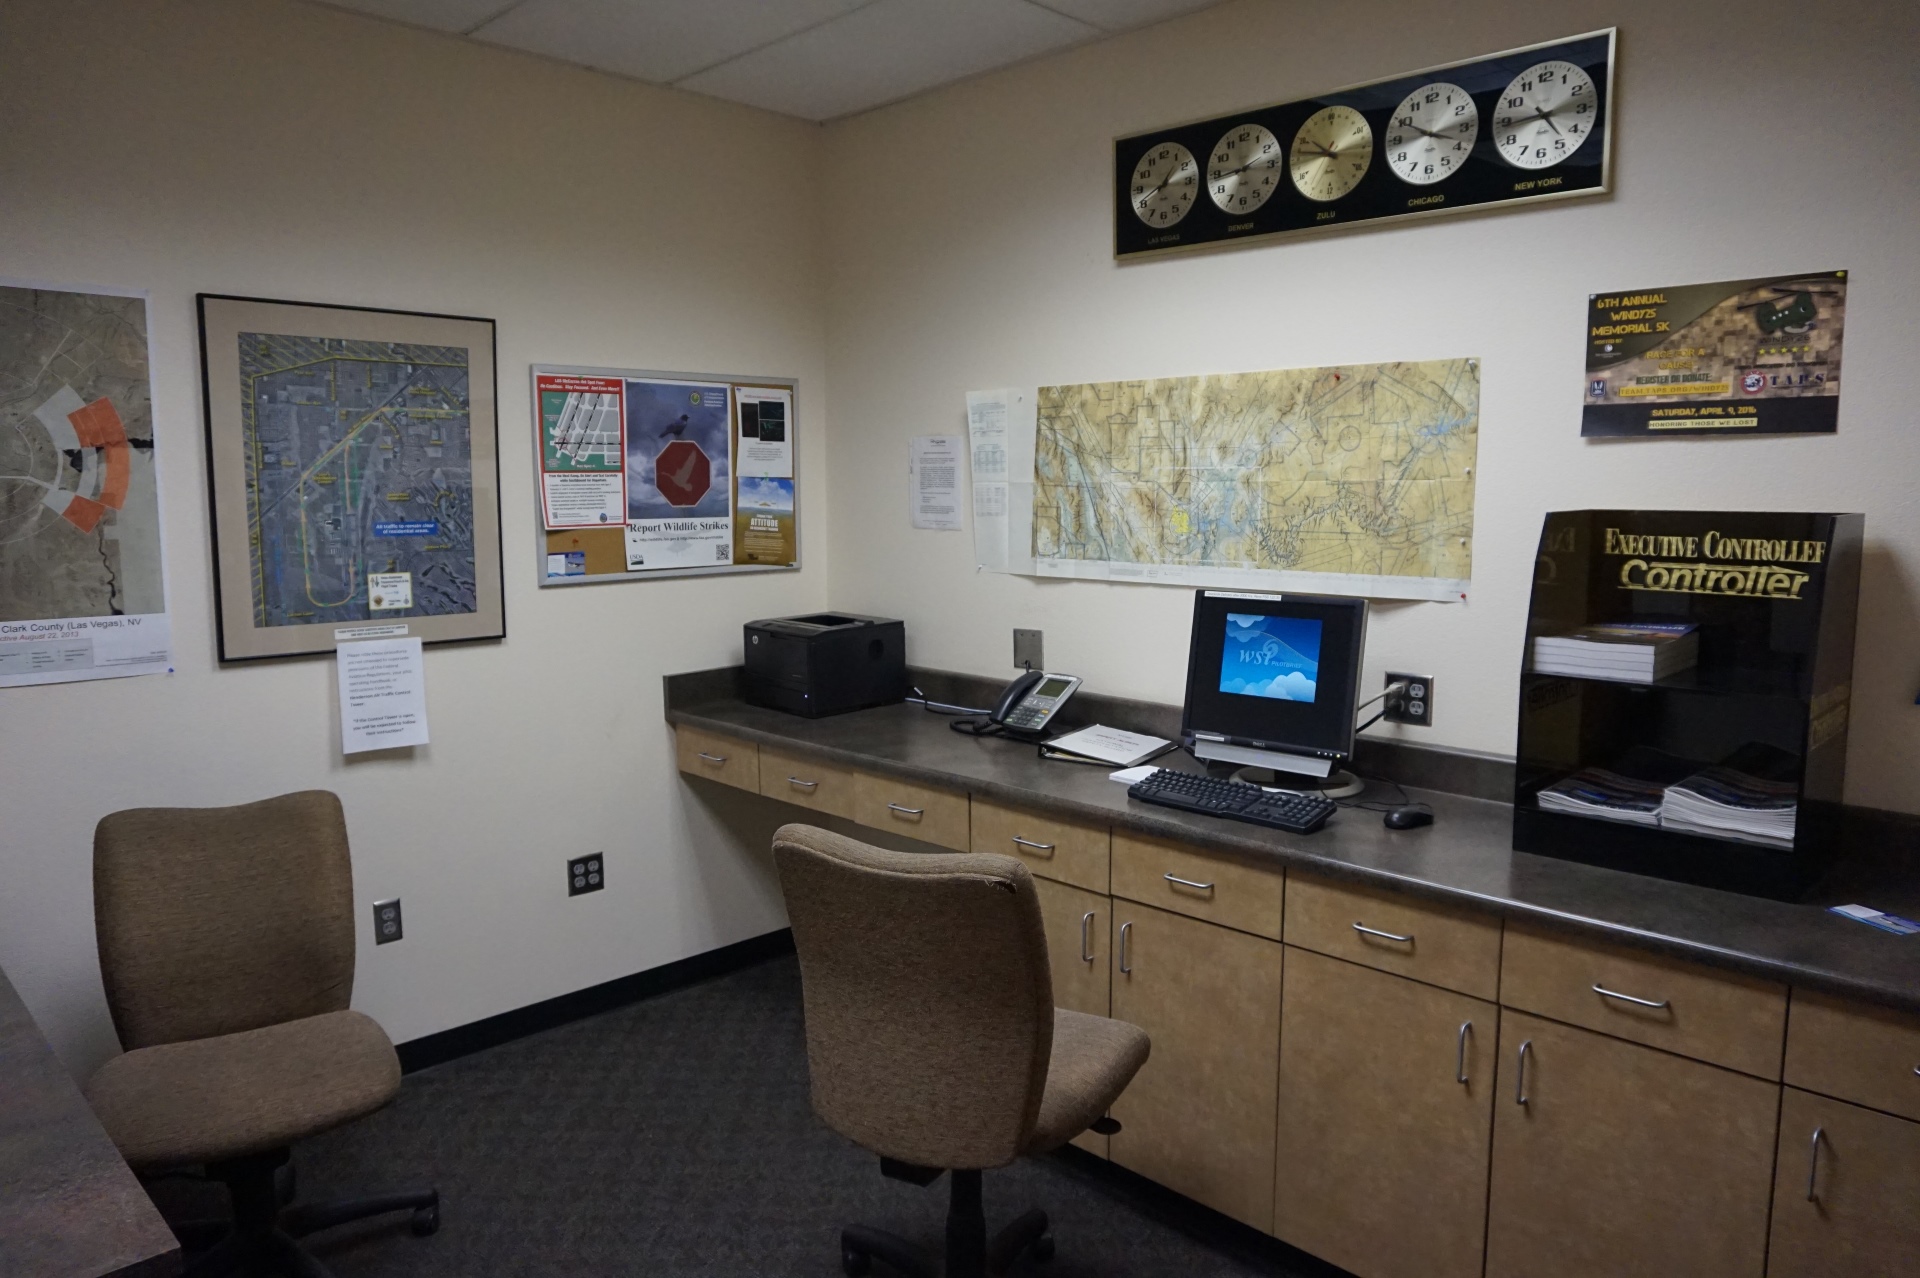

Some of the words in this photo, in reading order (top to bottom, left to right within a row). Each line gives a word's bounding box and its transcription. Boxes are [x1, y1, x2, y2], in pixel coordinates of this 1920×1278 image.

[1537, 71, 1554, 84] 12
[1562, 74, 1567, 85] 1
[1521, 81, 1533, 92] 11
[1571, 84, 1583, 97] 2
[1424, 91, 1440, 104] 12
[1410, 101, 1420, 112] 11
[1507, 97, 1524, 109] 10
[1455, 105, 1465, 116] 2
[1576, 103, 1587, 114] 3
[1398, 116, 1413, 128] 10
[1501, 117, 1512, 127] 9
[1460, 122, 1470, 133] 3
[1568, 123, 1579, 134] 4
[1239, 132, 1250, 142] 12
[1392, 135, 1403, 145] 9
[1506, 134, 1517, 145] 8
[1227, 140, 1235, 150] 11
[1263, 144, 1271, 154] 2
[1452, 141, 1462, 151] 4
[1554, 138, 1566, 150] 5
[1159, 150, 1169, 160] 12
[1519, 145, 1529, 156] 7
[1536, 148, 1547, 159] 6
[1217, 153, 1229, 163] 10
[1397, 151, 1407, 162] 8
[1440, 156, 1451, 167] 5
[1148, 158, 1156, 167] 11
[1181, 162, 1188, 171] 2
[1267, 160, 1275, 169] 3
[1409, 162, 1419, 172] 7
[1424, 164, 1434, 174] 6
[1140, 170, 1150, 179] 10
[1184, 177, 1192, 185] 3
[1261, 176, 1269, 185] 4
[1514, 181, 1535, 191] NEW
[1537, 177, 1563, 188] YORK
[1136, 186, 1143, 194] 9
[1217, 185, 1225, 194] 8
[1252, 189, 1260, 199] 5
[1180, 192, 1188, 200] 4
[1227, 194, 1234, 203] 7
[1408, 194, 1445, 207] CHICAGO
[1140, 200, 1147, 208] 8
[1240, 197, 1247, 206] 6
[1149, 209, 1156, 217] 7
[1172, 205, 1179, 213] 5
[1160, 212, 1167, 220] 6
[1316, 210, 1336, 220] ZULU
[1228, 222, 1254, 232] DENVER
[1160, 233, 1180, 243] VEGAS
[1597, 298, 1620, 309] 6TH
[1621, 294, 1667, 307] ANNUAL
[1592, 323, 1653, 336] MEMORIAL
[1675, 349, 1695, 358] FOR
[1698, 348, 1705, 356] A
[1652, 407, 1698, 417] SATURDAY,
[1700, 407, 1725, 415] APRIL
[1649, 420, 1687, 428] HONORING
[630, 523, 661, 534] Report
[663, 522, 698, 531] Wildlife
[700, 521, 729, 530] Strikes
[750, 517, 779, 528] ATTITUDE
[1605, 527, 1699, 558] EXECUTIVE
[1620, 559, 1810, 597] Controller
[1, 624, 27, 634] Clark
[30, 623, 64, 632] County
[67, 621, 88, 630] (Las
[127, 618, 142, 626] NV
[20, 633, 46, 642] August
